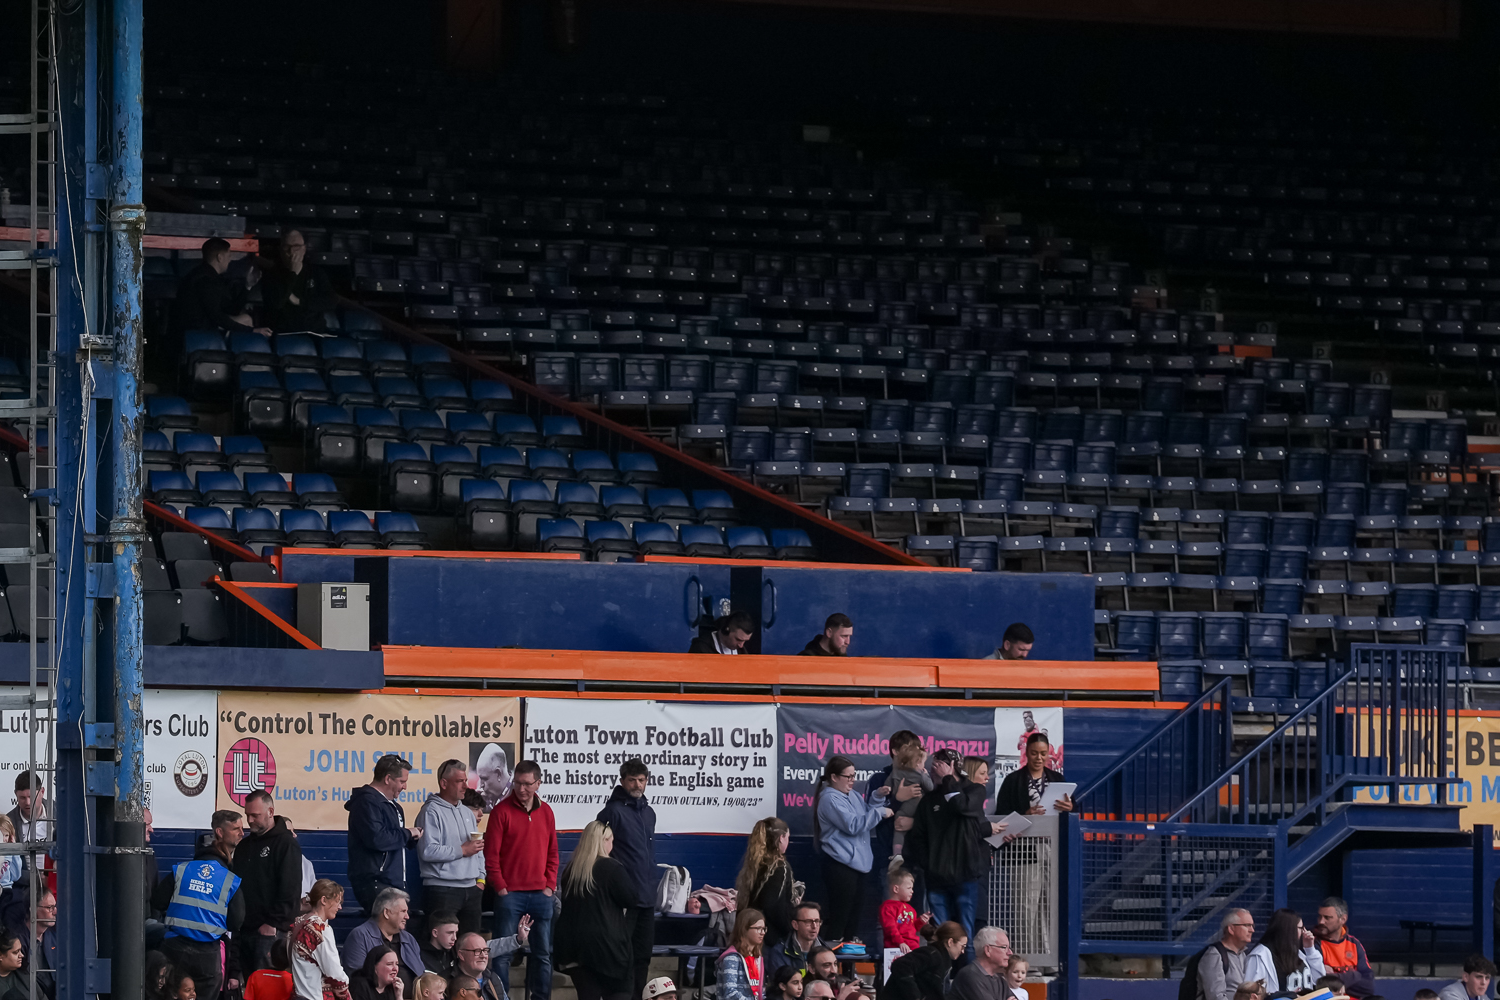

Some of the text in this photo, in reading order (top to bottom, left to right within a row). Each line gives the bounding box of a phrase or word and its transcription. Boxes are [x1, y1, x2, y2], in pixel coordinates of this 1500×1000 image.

[168, 714, 209, 737] Club
[220, 710, 515, 738] “Control The Controllables”
[525, 723, 774, 748] Luton Town Football Club
[784, 732, 830, 759] Pelly
[833, 734, 890, 755] Ruddo
[303, 749, 366, 773] JOHN
[530, 747, 559, 763] The
[563, 749, 601, 764] most
[710, 752, 749, 768] story
[752, 751, 768, 767] in
[147, 763, 167, 774] club
[783, 765, 818, 785] Every
[565, 769, 618, 787] history
[647, 771, 670, 786] he
[669, 771, 722, 790] English
[727, 774, 765, 790] game
[1449, 771, 1473, 802] in
[275, 785, 329, 801] Luton’s
[651, 795, 677, 806] LUTON
[679, 795, 720, 808] OUTLAWS,
[783, 793, 814, 807] We'v
[188, 883, 213, 895] HELP
[190, 879, 205, 887] HERE
